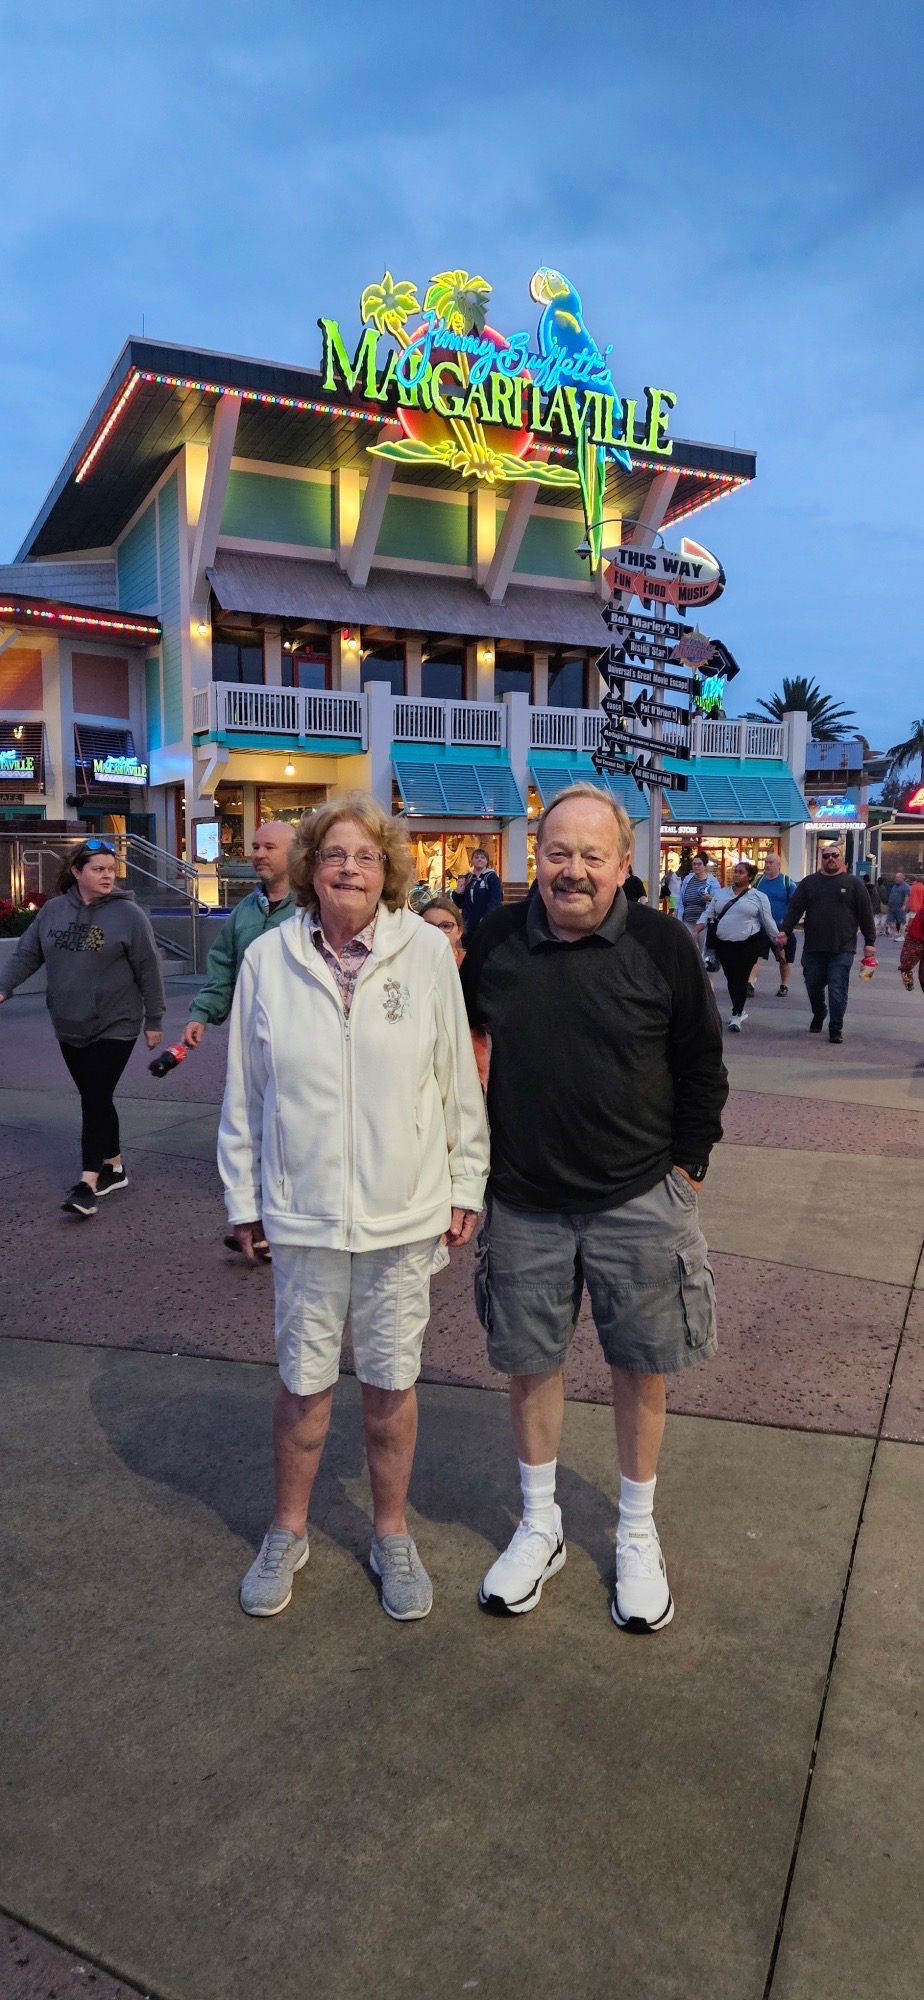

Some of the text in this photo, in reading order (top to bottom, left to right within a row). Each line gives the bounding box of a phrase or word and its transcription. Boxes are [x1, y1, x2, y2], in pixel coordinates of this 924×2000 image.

[396, 310, 613, 393] Jimmy Buffett's
[318, 317, 678, 456] MARGARITAVILLE
[618, 549, 703, 578] THIS WAY
[614, 571, 631, 588] FUN
[643, 580, 666, 598] FOOD
[678, 585, 709, 601] MUSIC
[611, 613, 675, 634] Bob Marley's
[630, 642, 666, 657] Rising Star
[607, 664, 689, 691] Universal's Great Movie Escape
[607, 702, 622, 711] dance
[640, 703, 676, 719] Pat O'Brien's
[0, 757, 34, 771] TAVILLE
[678, 826, 698, 834] STORE
[47, 929, 87, 942] NORTH
[68, 922, 89, 933] THE
[54, 939, 83, 951] FACE
